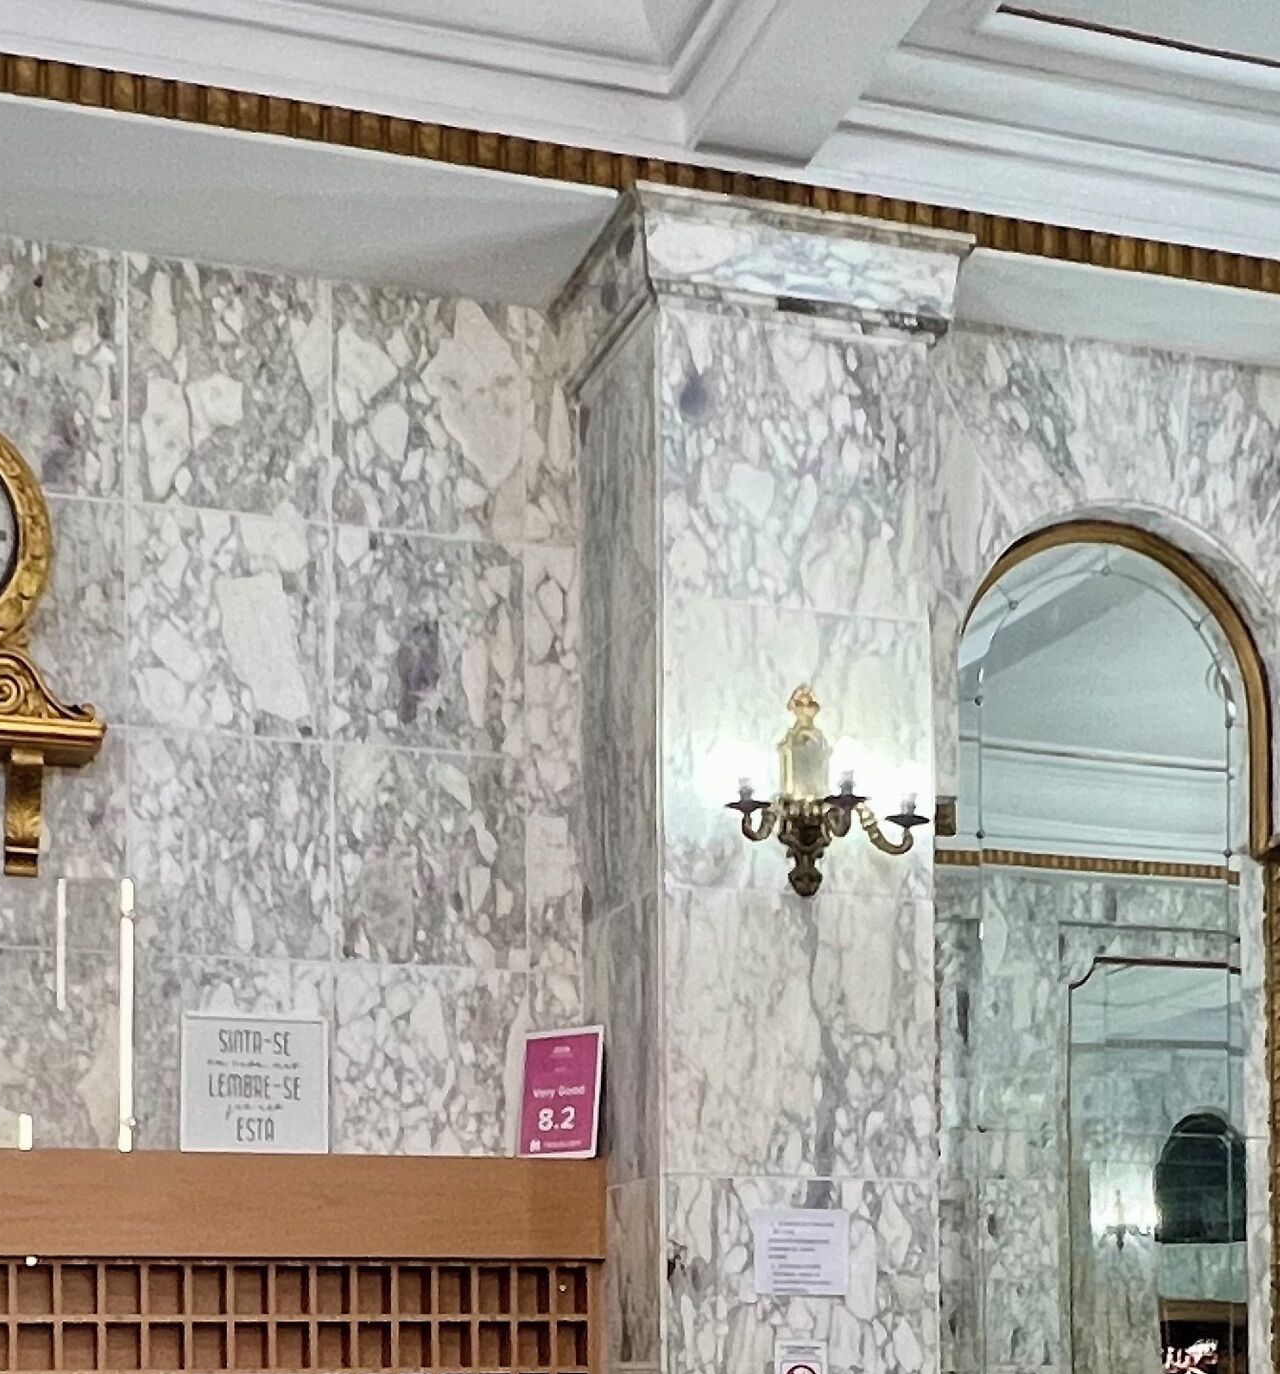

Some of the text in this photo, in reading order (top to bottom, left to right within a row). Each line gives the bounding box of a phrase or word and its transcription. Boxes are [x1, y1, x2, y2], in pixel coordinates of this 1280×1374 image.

[219, 1028, 291, 1057] SINTA-SE
[208, 1072, 302, 1101] LEMBRE-SE
[538, 1105, 575, 1132] 8.2
